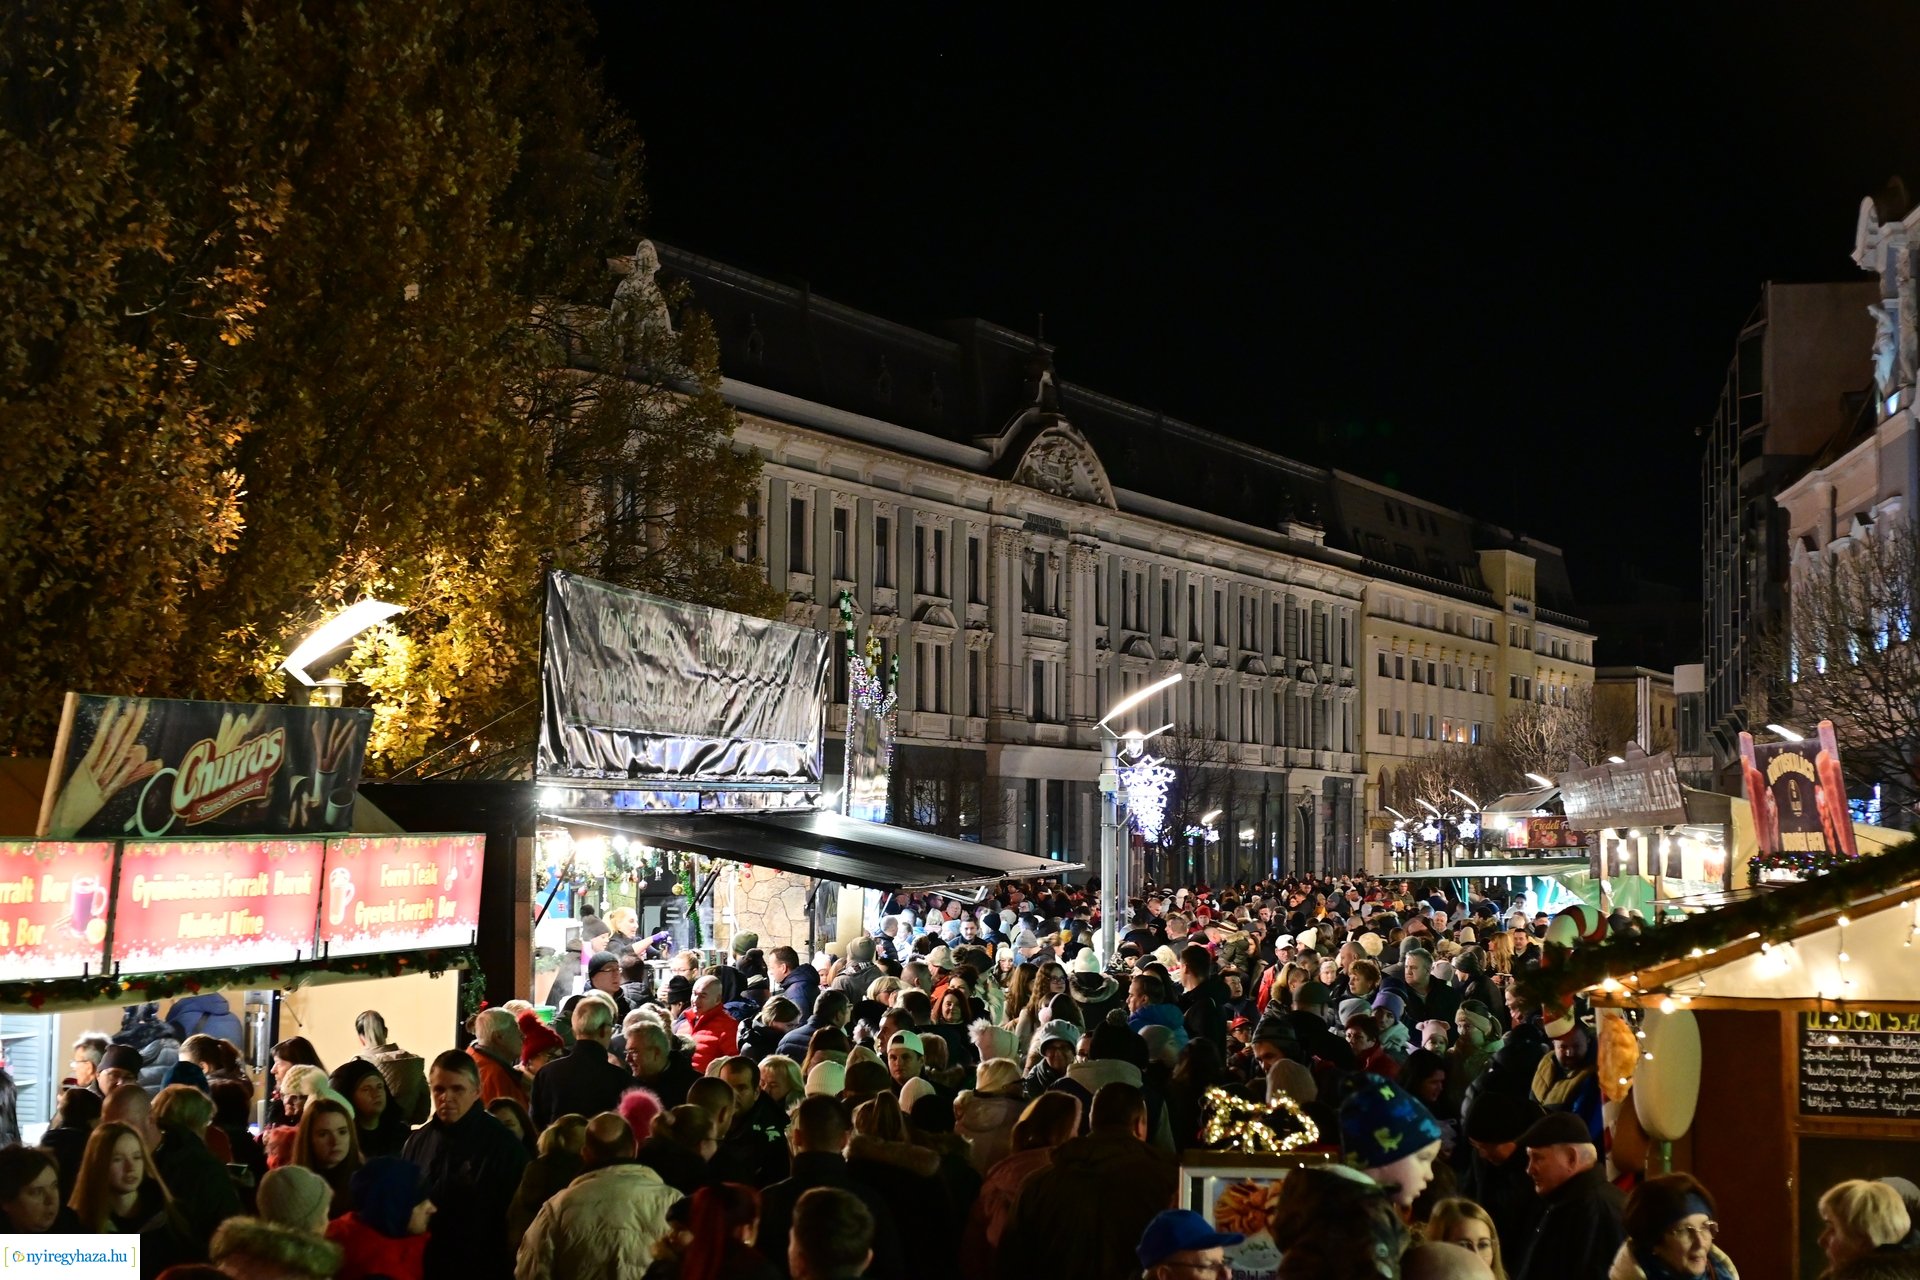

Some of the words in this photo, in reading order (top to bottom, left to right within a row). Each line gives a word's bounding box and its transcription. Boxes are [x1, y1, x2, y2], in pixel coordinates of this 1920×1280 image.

[173, 731, 282, 810] Churros
[40, 873, 69, 904] Bor
[396, 897, 435, 923] Forralt
[437, 895, 457, 919] Bor
[15, 917, 46, 947] Bor
